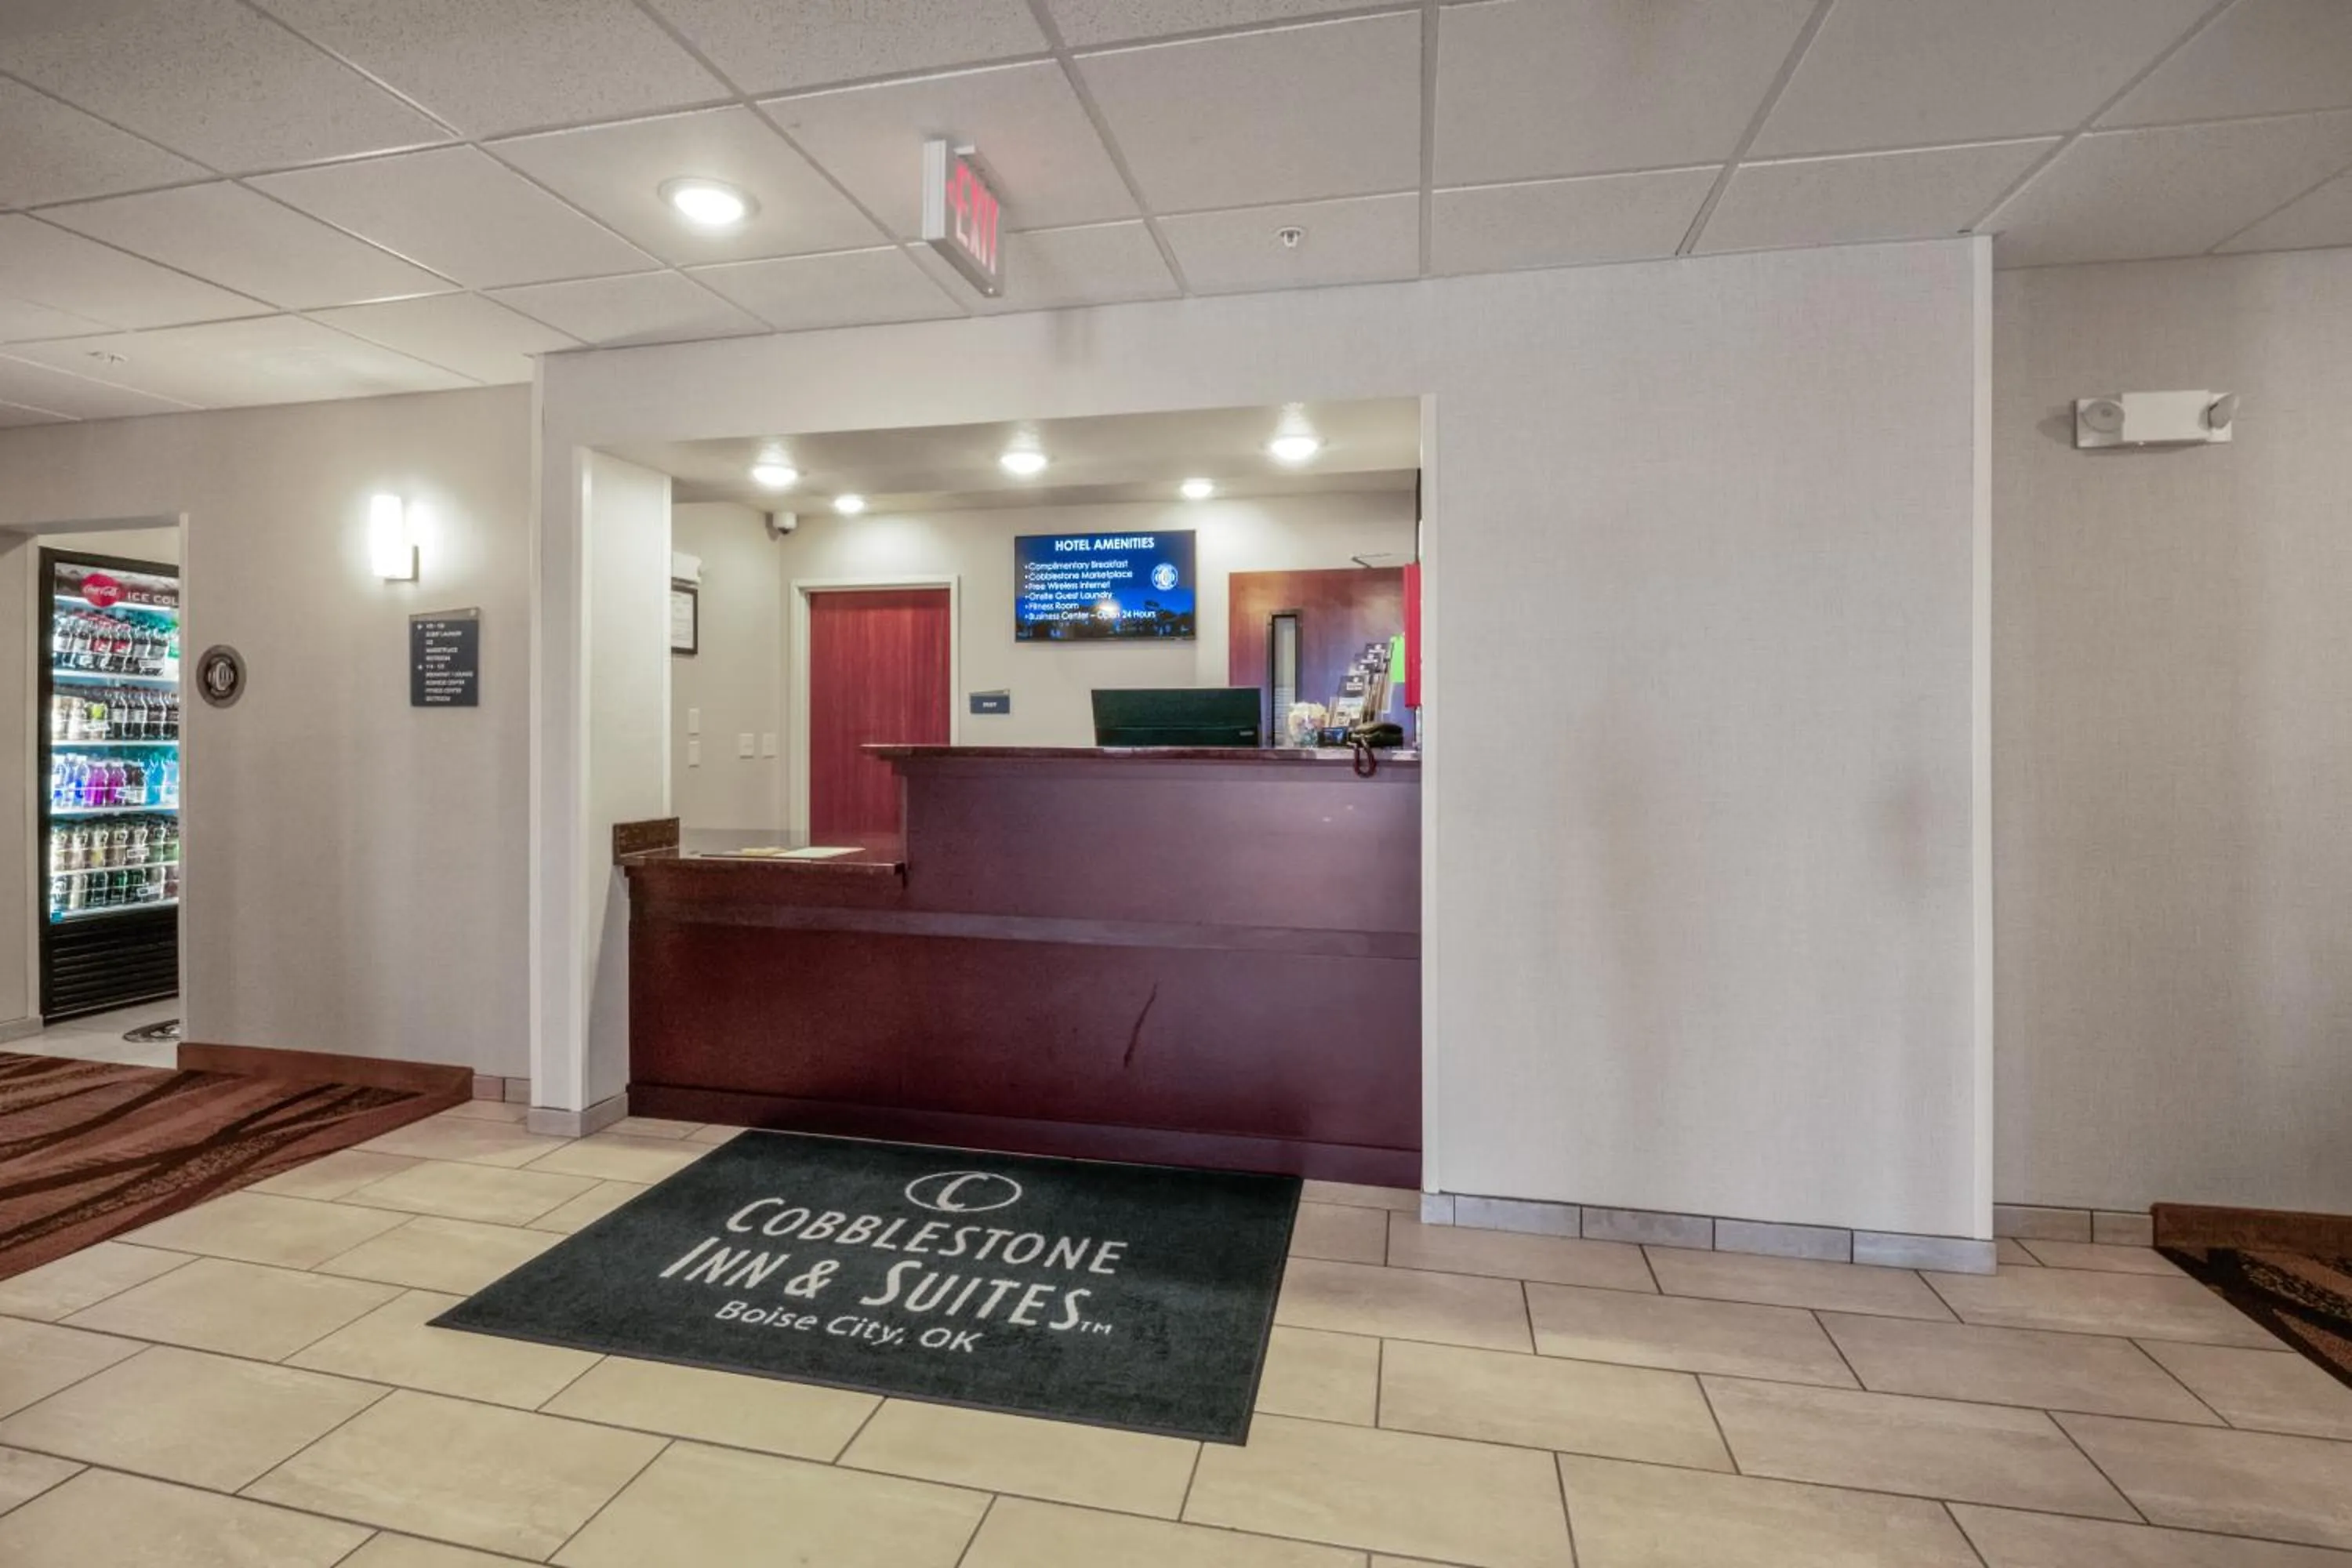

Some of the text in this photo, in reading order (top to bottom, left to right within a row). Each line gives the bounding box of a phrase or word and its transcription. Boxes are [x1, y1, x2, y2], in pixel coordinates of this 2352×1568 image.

[1054, 537, 1155, 551] HOTEL AMENITIES
[1028, 560, 1128, 572] Complimentary Breakfast
[1047, 581, 1078, 590] Wireless
[1080, 580, 1111, 589] Internet
[128, 592, 179, 605] ICE COL
[1080, 590, 1113, 601] Laundry
[1061, 611, 1089, 619] Center
[1122, 610, 1133, 619] 24
[1133, 610, 1156, 619] Hours
[726, 1197, 1127, 1275] COBBLESTONE
[659, 1236, 788, 1289] INN
[785, 1259, 840, 1298] &
[860, 1260, 1092, 1332] SUITES
[714, 1299, 986, 1353] Boise City, OK
